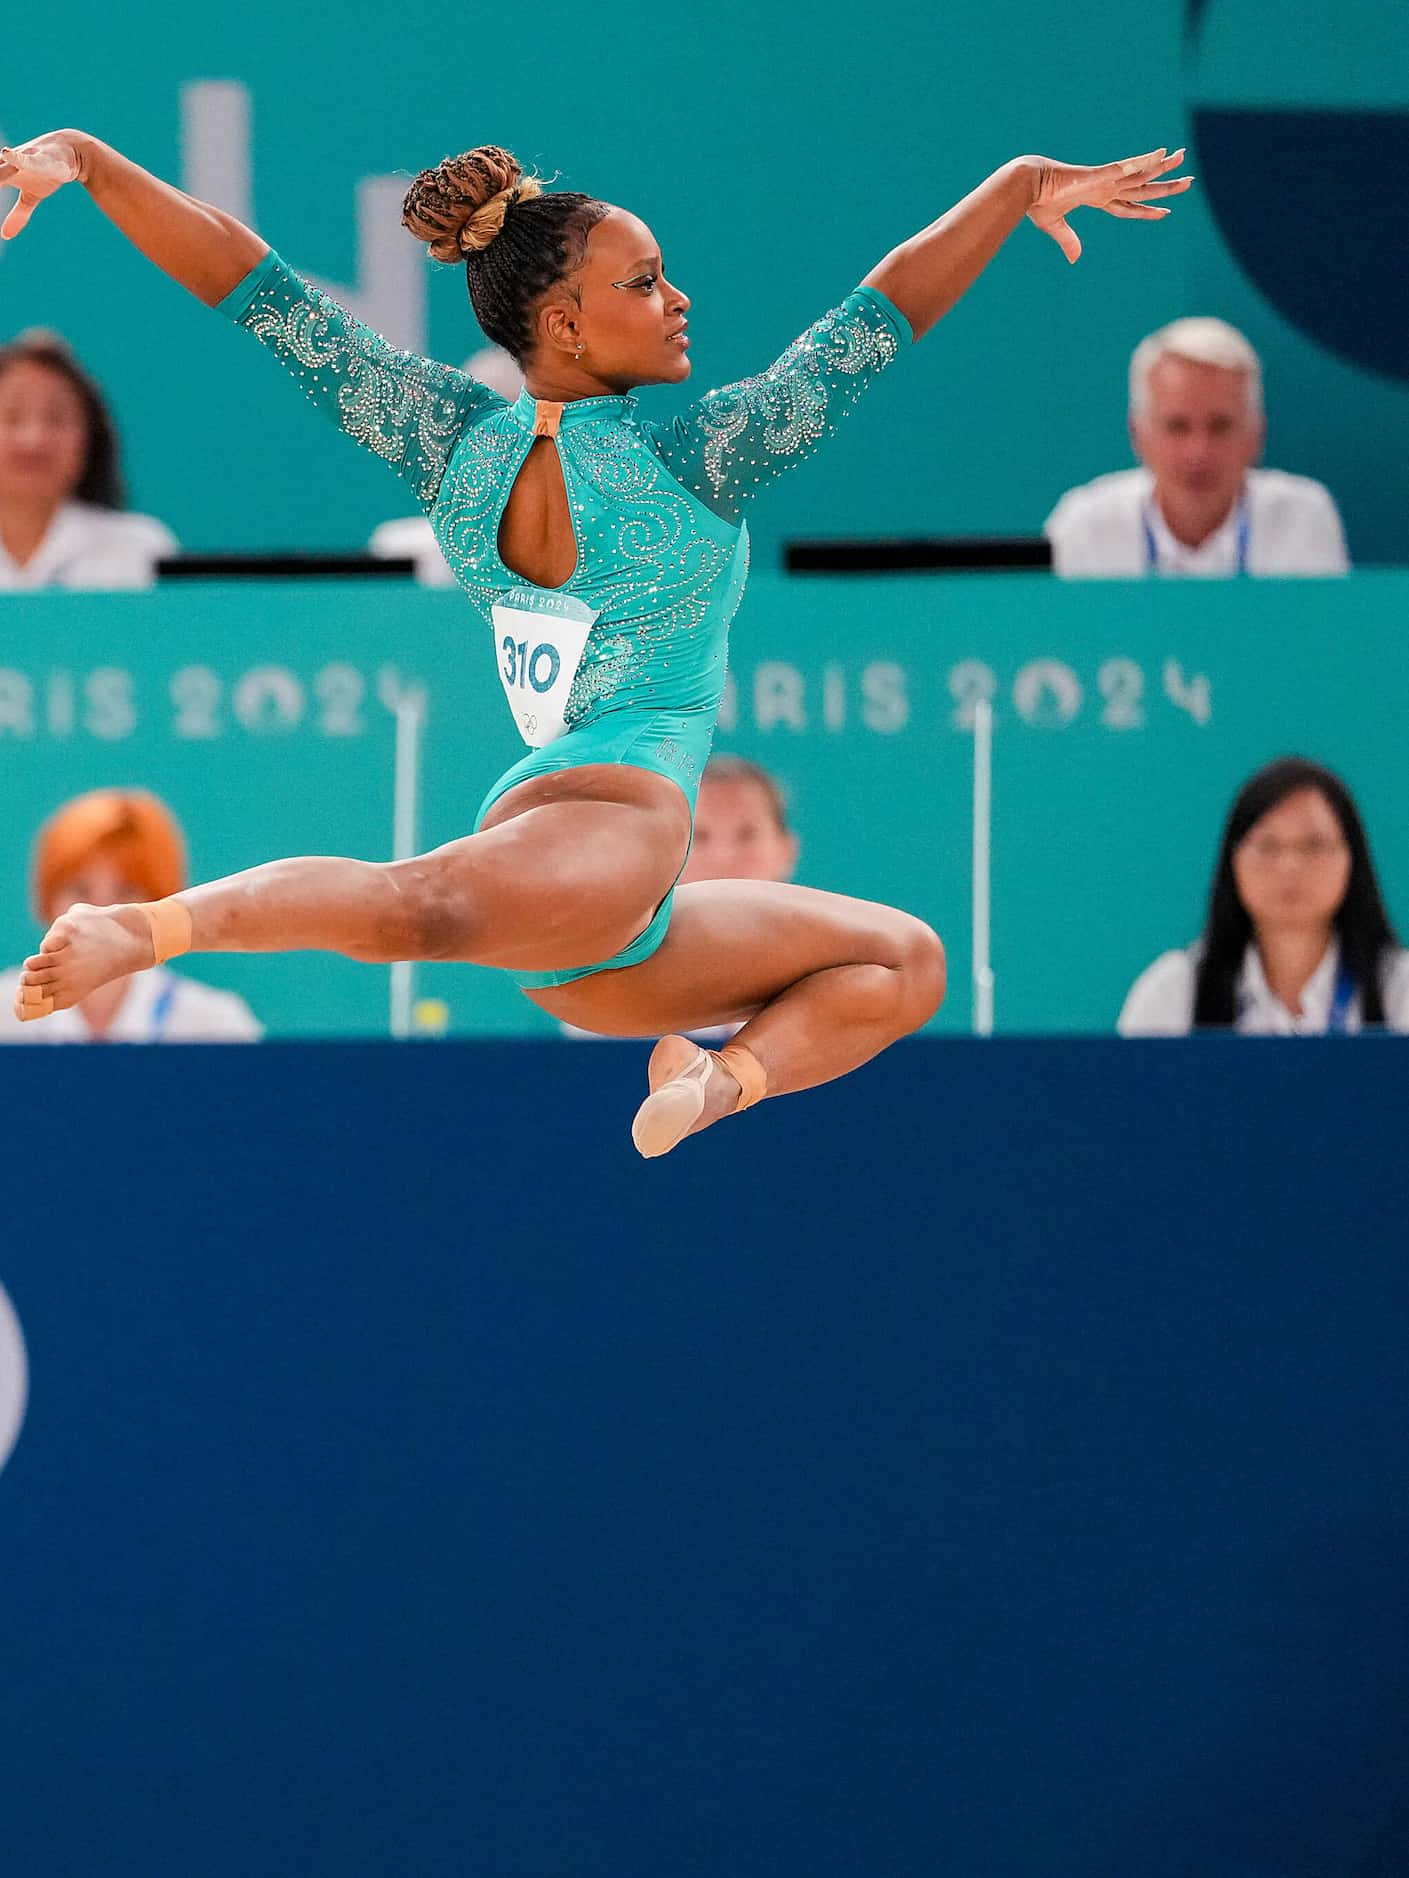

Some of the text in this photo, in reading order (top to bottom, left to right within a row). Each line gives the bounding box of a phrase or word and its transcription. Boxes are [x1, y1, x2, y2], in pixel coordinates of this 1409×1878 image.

[509, 590, 569, 610] PARIS 2024
[502, 635, 561, 694] 310
[718, 657, 1210, 733] RIS 2024
